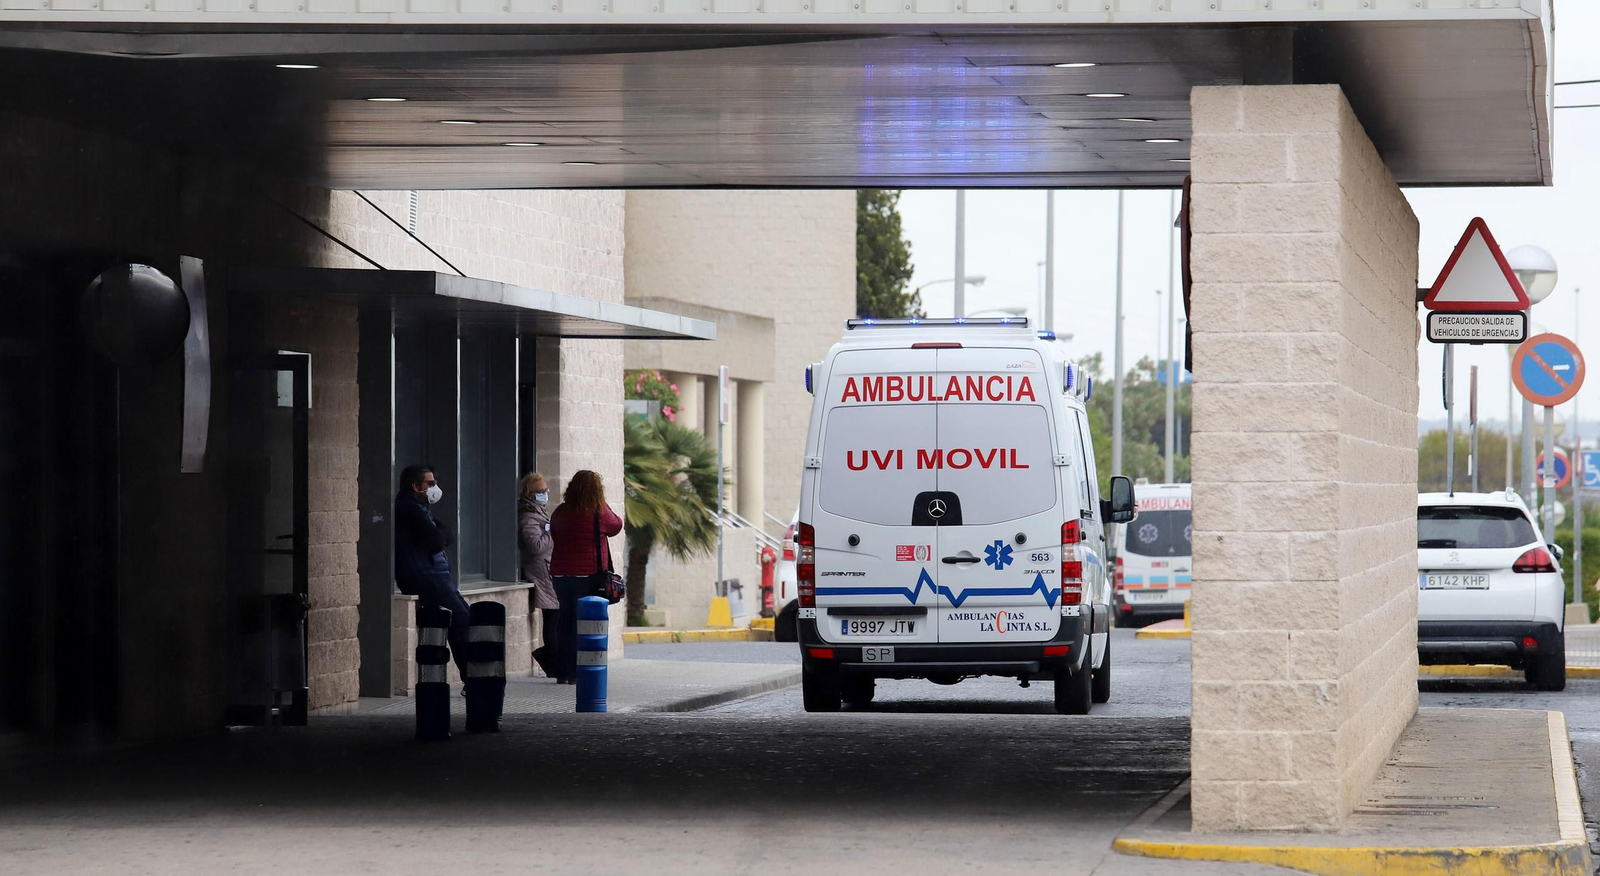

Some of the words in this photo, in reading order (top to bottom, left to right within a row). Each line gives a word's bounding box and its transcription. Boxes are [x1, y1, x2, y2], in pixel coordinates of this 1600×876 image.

[1438, 316, 1480, 325] PRECAUCION
[1481, 317, 1504, 326] SALIDA
[1506, 317, 1515, 326] DE
[1434, 328, 1470, 337] VEHICULOS
[1472, 328, 1480, 337] DE
[1482, 328, 1519, 337] URGENCIAS
[841, 375, 1036, 402] AMBULANCIA
[846, 449, 903, 471] UVI
[917, 448, 1030, 470] MOVIL
[1135, 498, 1191, 510] AMBULAN
[1031, 553, 1050, 562] 563
[1428, 576, 1459, 586] 6142
[1463, 576, 1485, 586] KHP
[947, 611, 1024, 625] AMBULANCIAS
[851, 620, 885, 634] 9997
[890, 620, 916, 634] JTW
[980, 622, 994, 632] LA
[996, 616, 1032, 634] CINTA
[1034, 622, 1052, 631] S.L.
